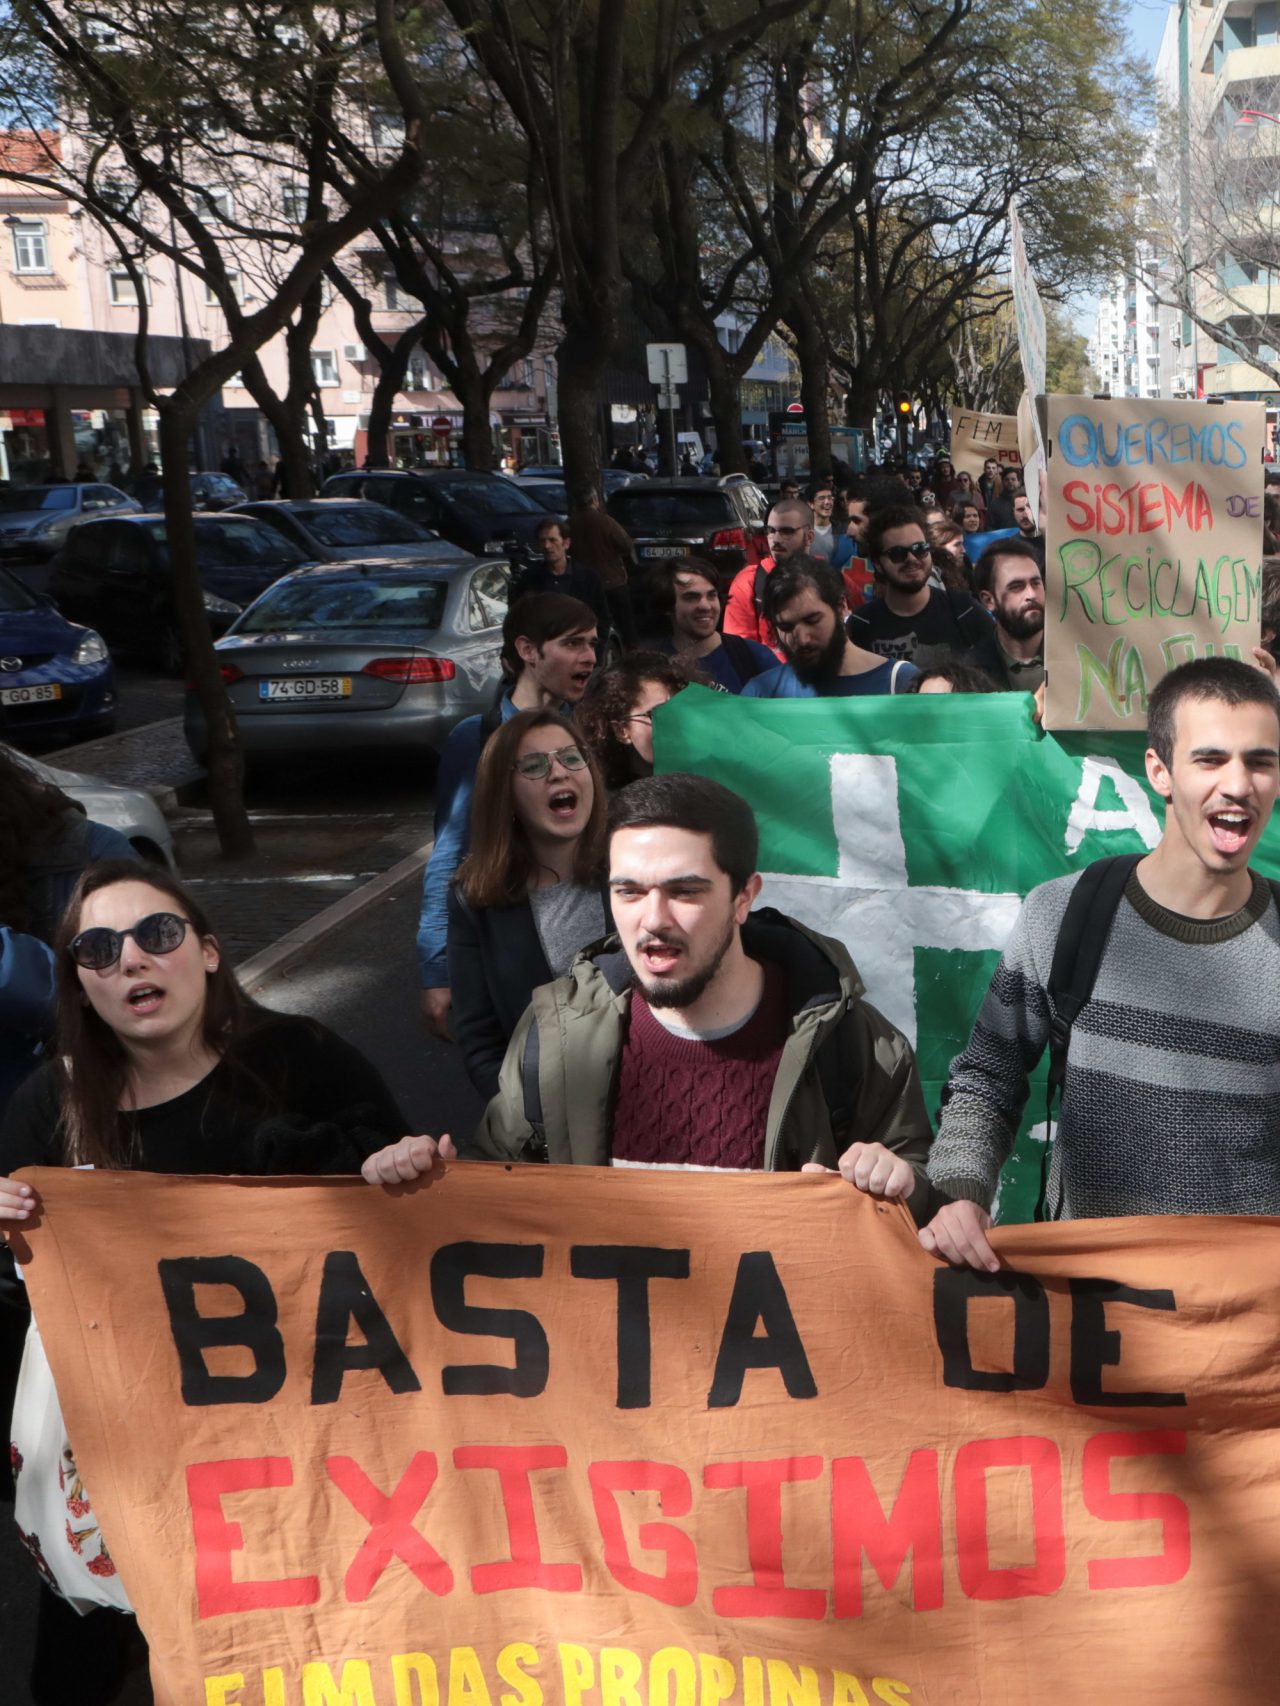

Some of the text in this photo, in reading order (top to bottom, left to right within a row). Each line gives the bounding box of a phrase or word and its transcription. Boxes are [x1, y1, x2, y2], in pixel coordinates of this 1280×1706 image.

[956, 416, 1002, 443] FIM
[1057, 415, 1248, 469] QUEREMOS
[1226, 495, 1260, 518] DE
[1074, 636, 1149, 723] NA
[158, 1241, 818, 1409] BASTA
[933, 1265, 1188, 1408] DE
[186, 1430, 1191, 1622] EXIGIMOS
